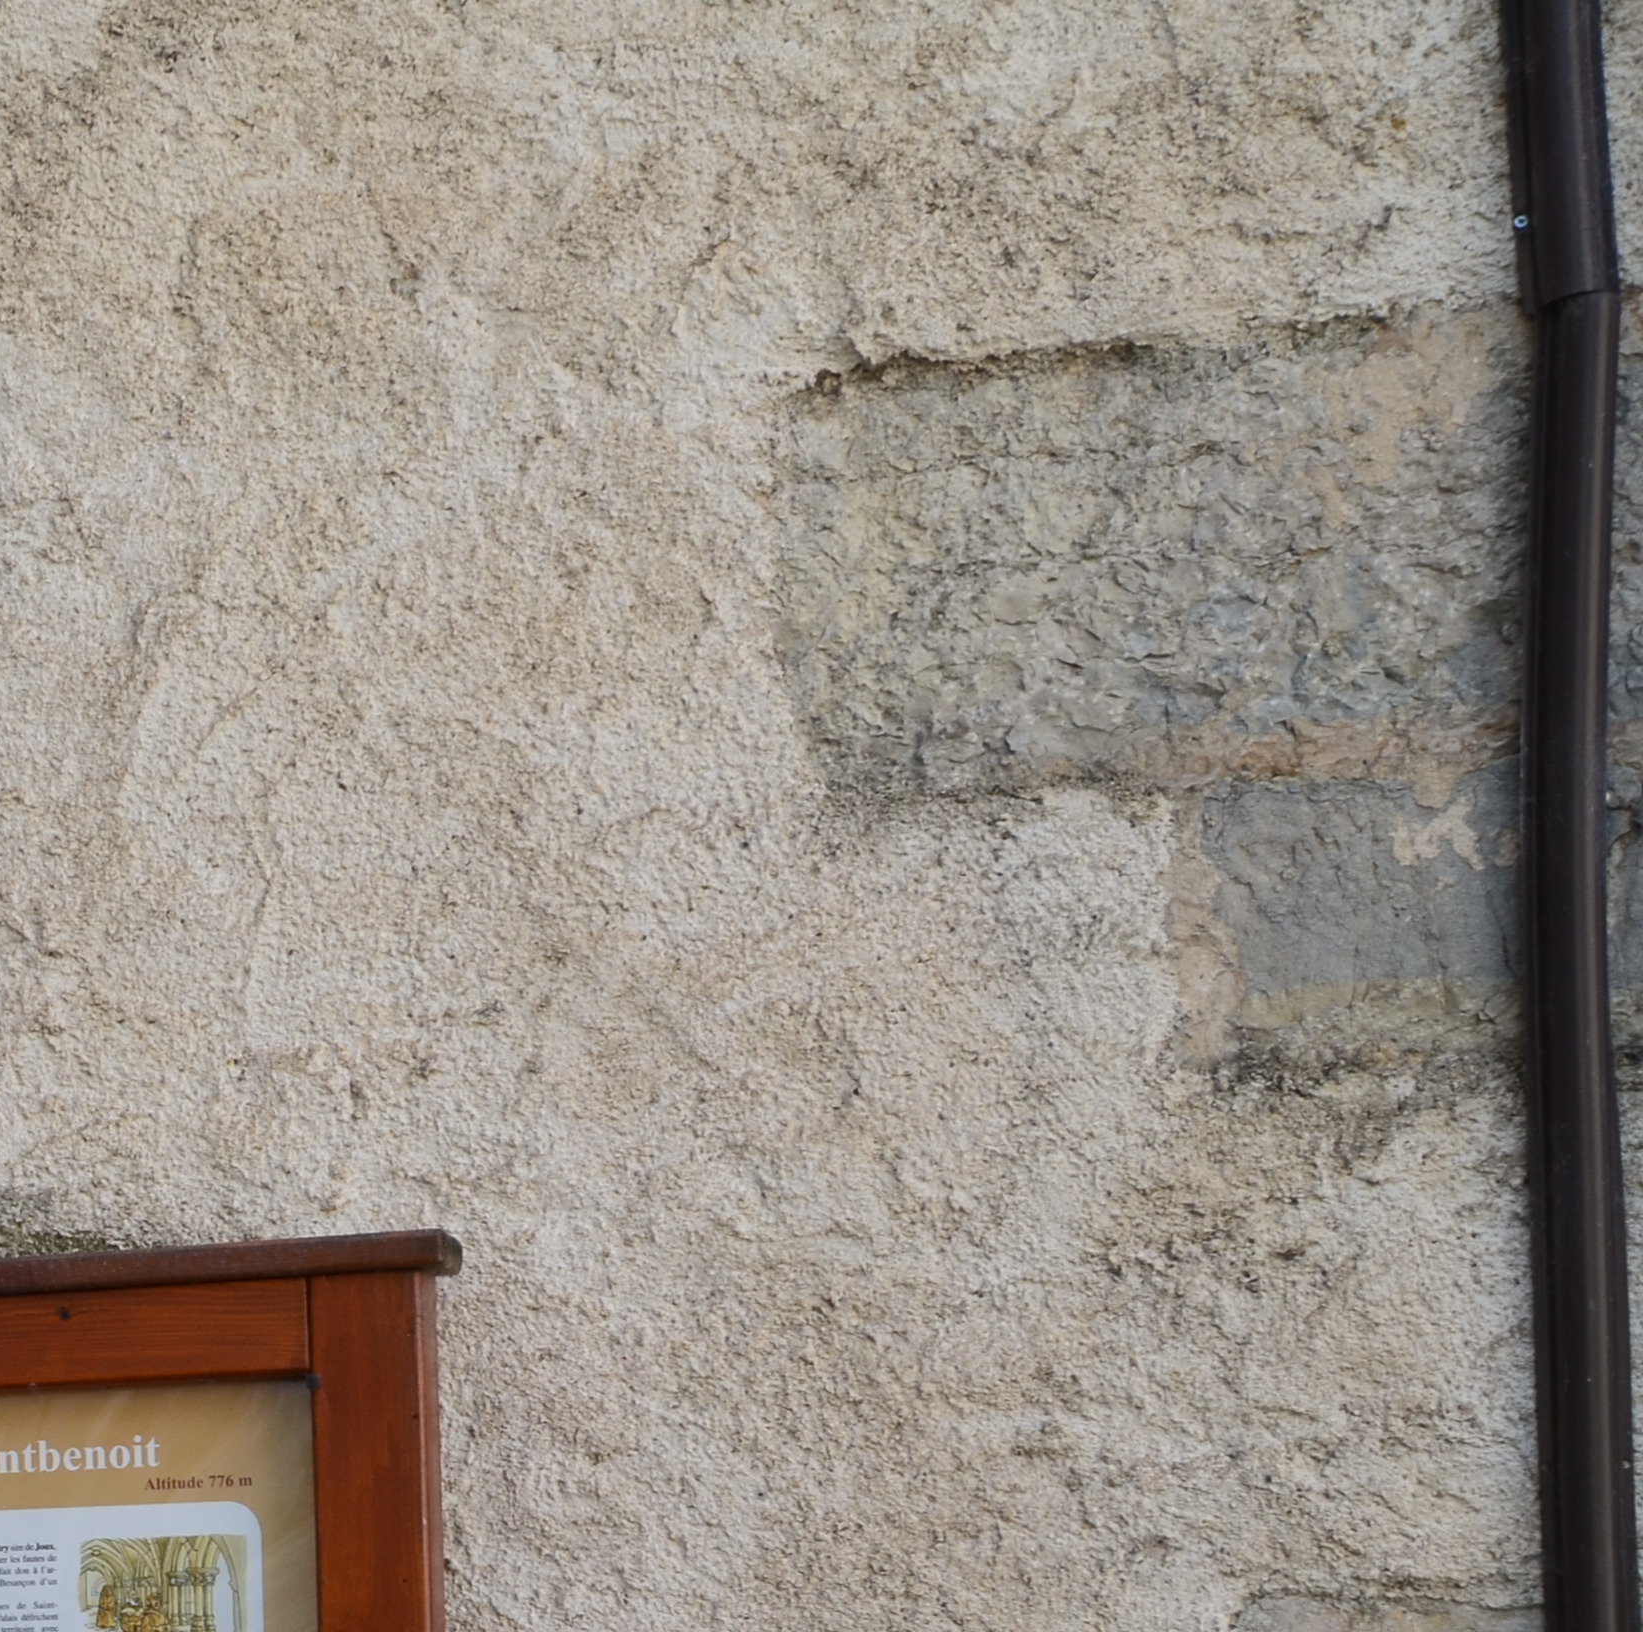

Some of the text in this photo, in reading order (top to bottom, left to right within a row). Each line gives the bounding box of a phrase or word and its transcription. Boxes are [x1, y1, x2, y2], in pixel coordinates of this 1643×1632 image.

[145, 1475, 252, 1490] Altitude 776 m
